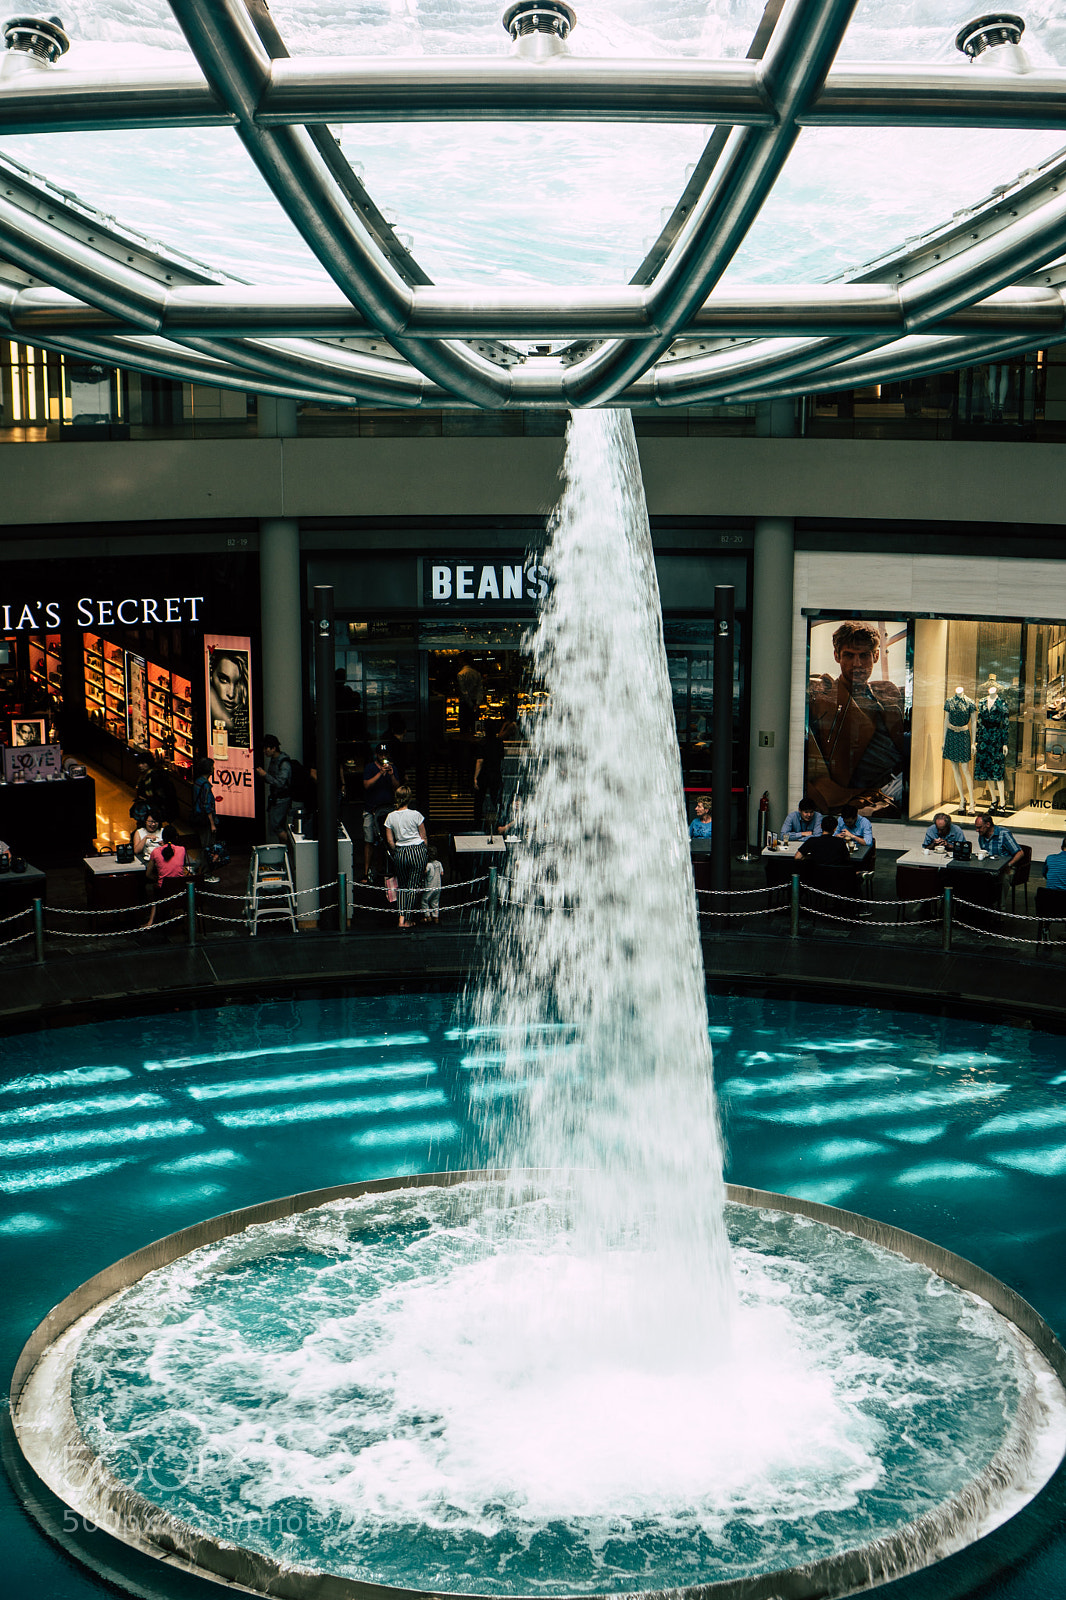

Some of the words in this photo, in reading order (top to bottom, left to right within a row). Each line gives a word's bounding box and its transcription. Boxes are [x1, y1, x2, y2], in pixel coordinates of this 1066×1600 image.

[432, 565, 549, 600] BEANS
[77, 597, 204, 627] SECRET
[12, 751, 55, 769] LOVE
[211, 769, 252, 788] LOVE
